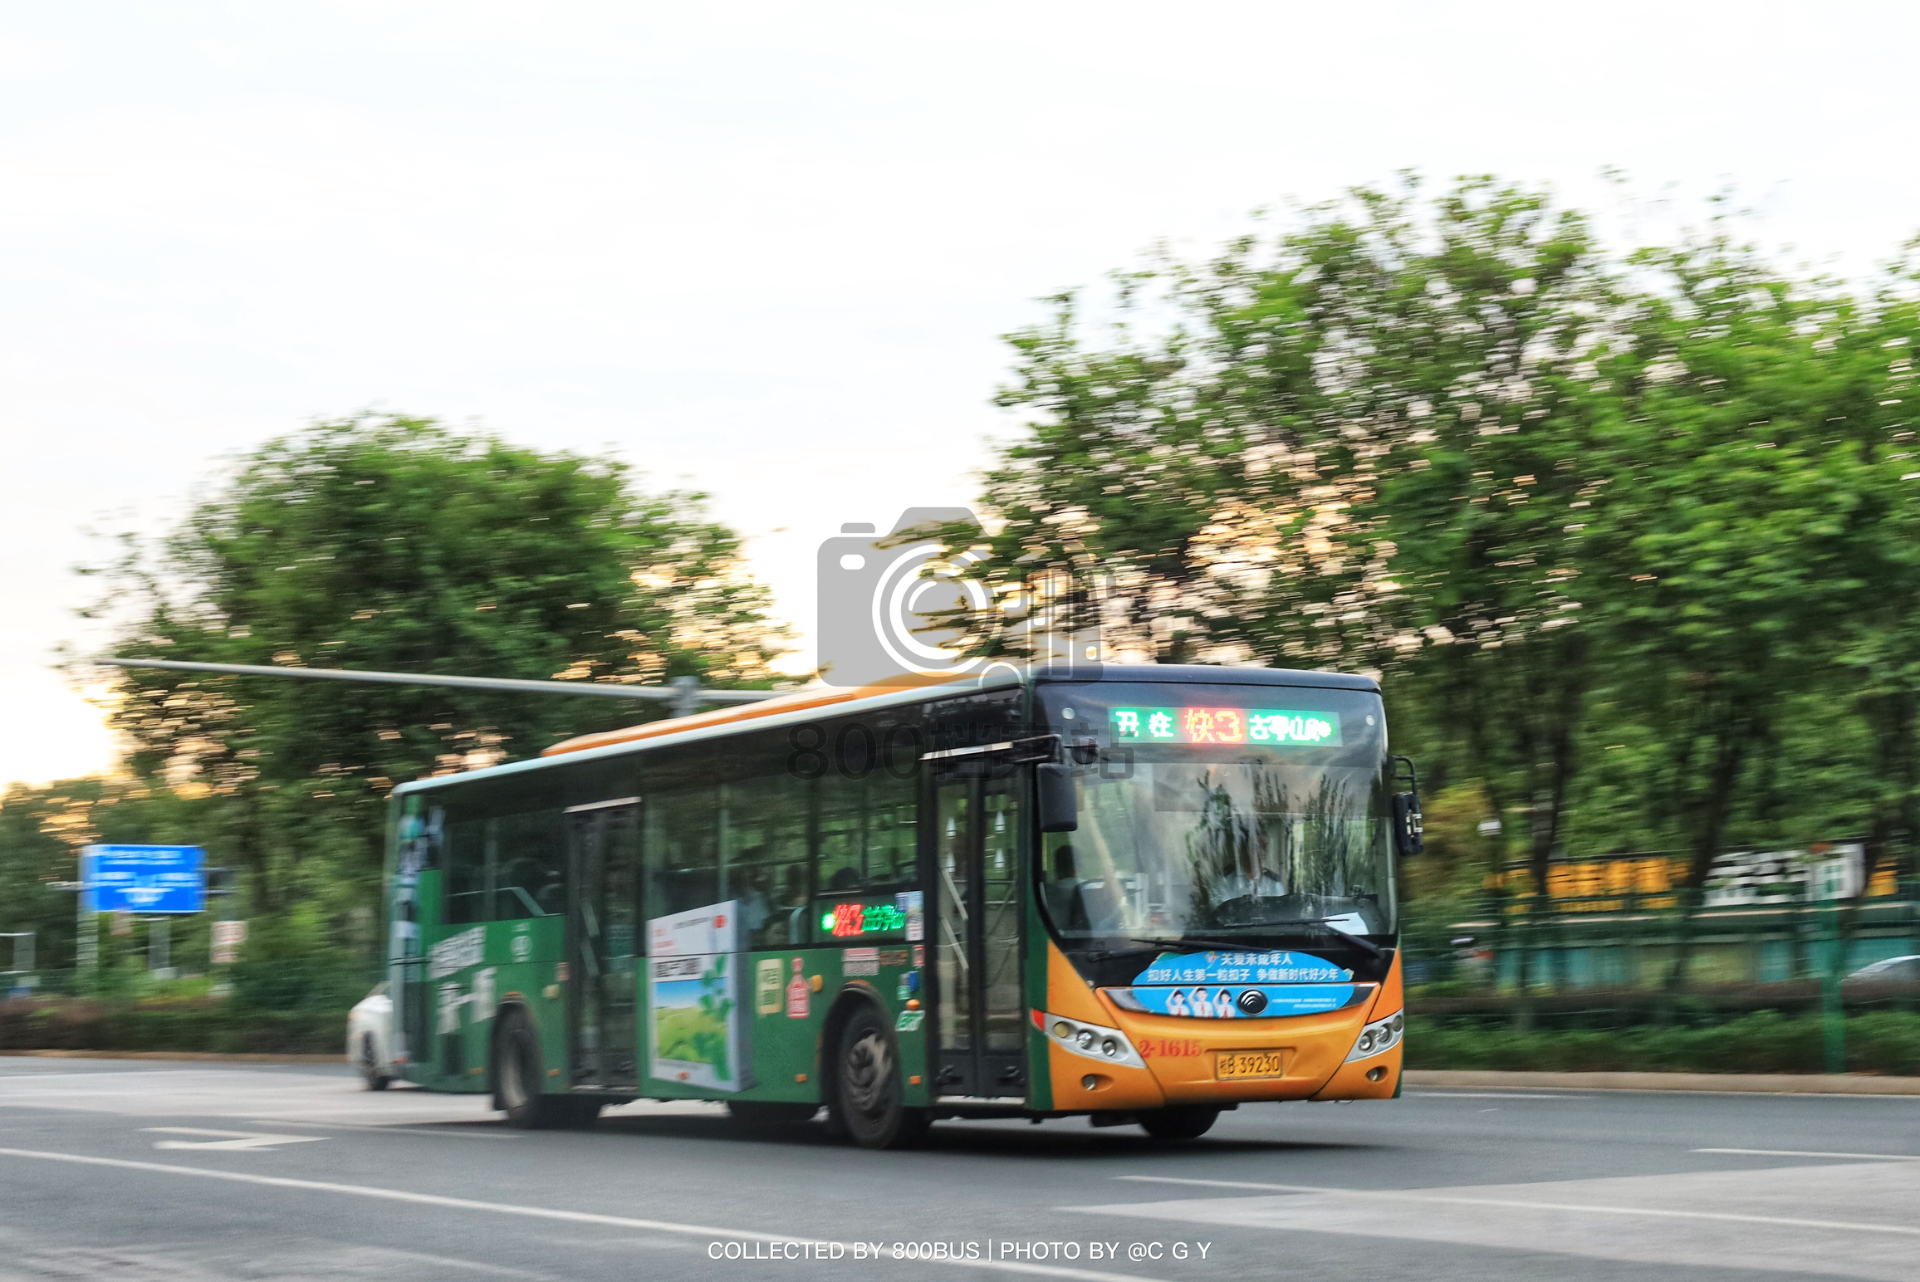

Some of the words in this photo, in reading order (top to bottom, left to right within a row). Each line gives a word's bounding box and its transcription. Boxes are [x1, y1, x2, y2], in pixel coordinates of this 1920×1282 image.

[1221, 952, 1293, 966] 关爱未成年人
[1147, 968, 1250, 982] 扣好人生第一粒扣子
[1257, 968, 1338, 981] 争做新时代好少年
[1138, 1039, 1203, 1059] 2-1615
